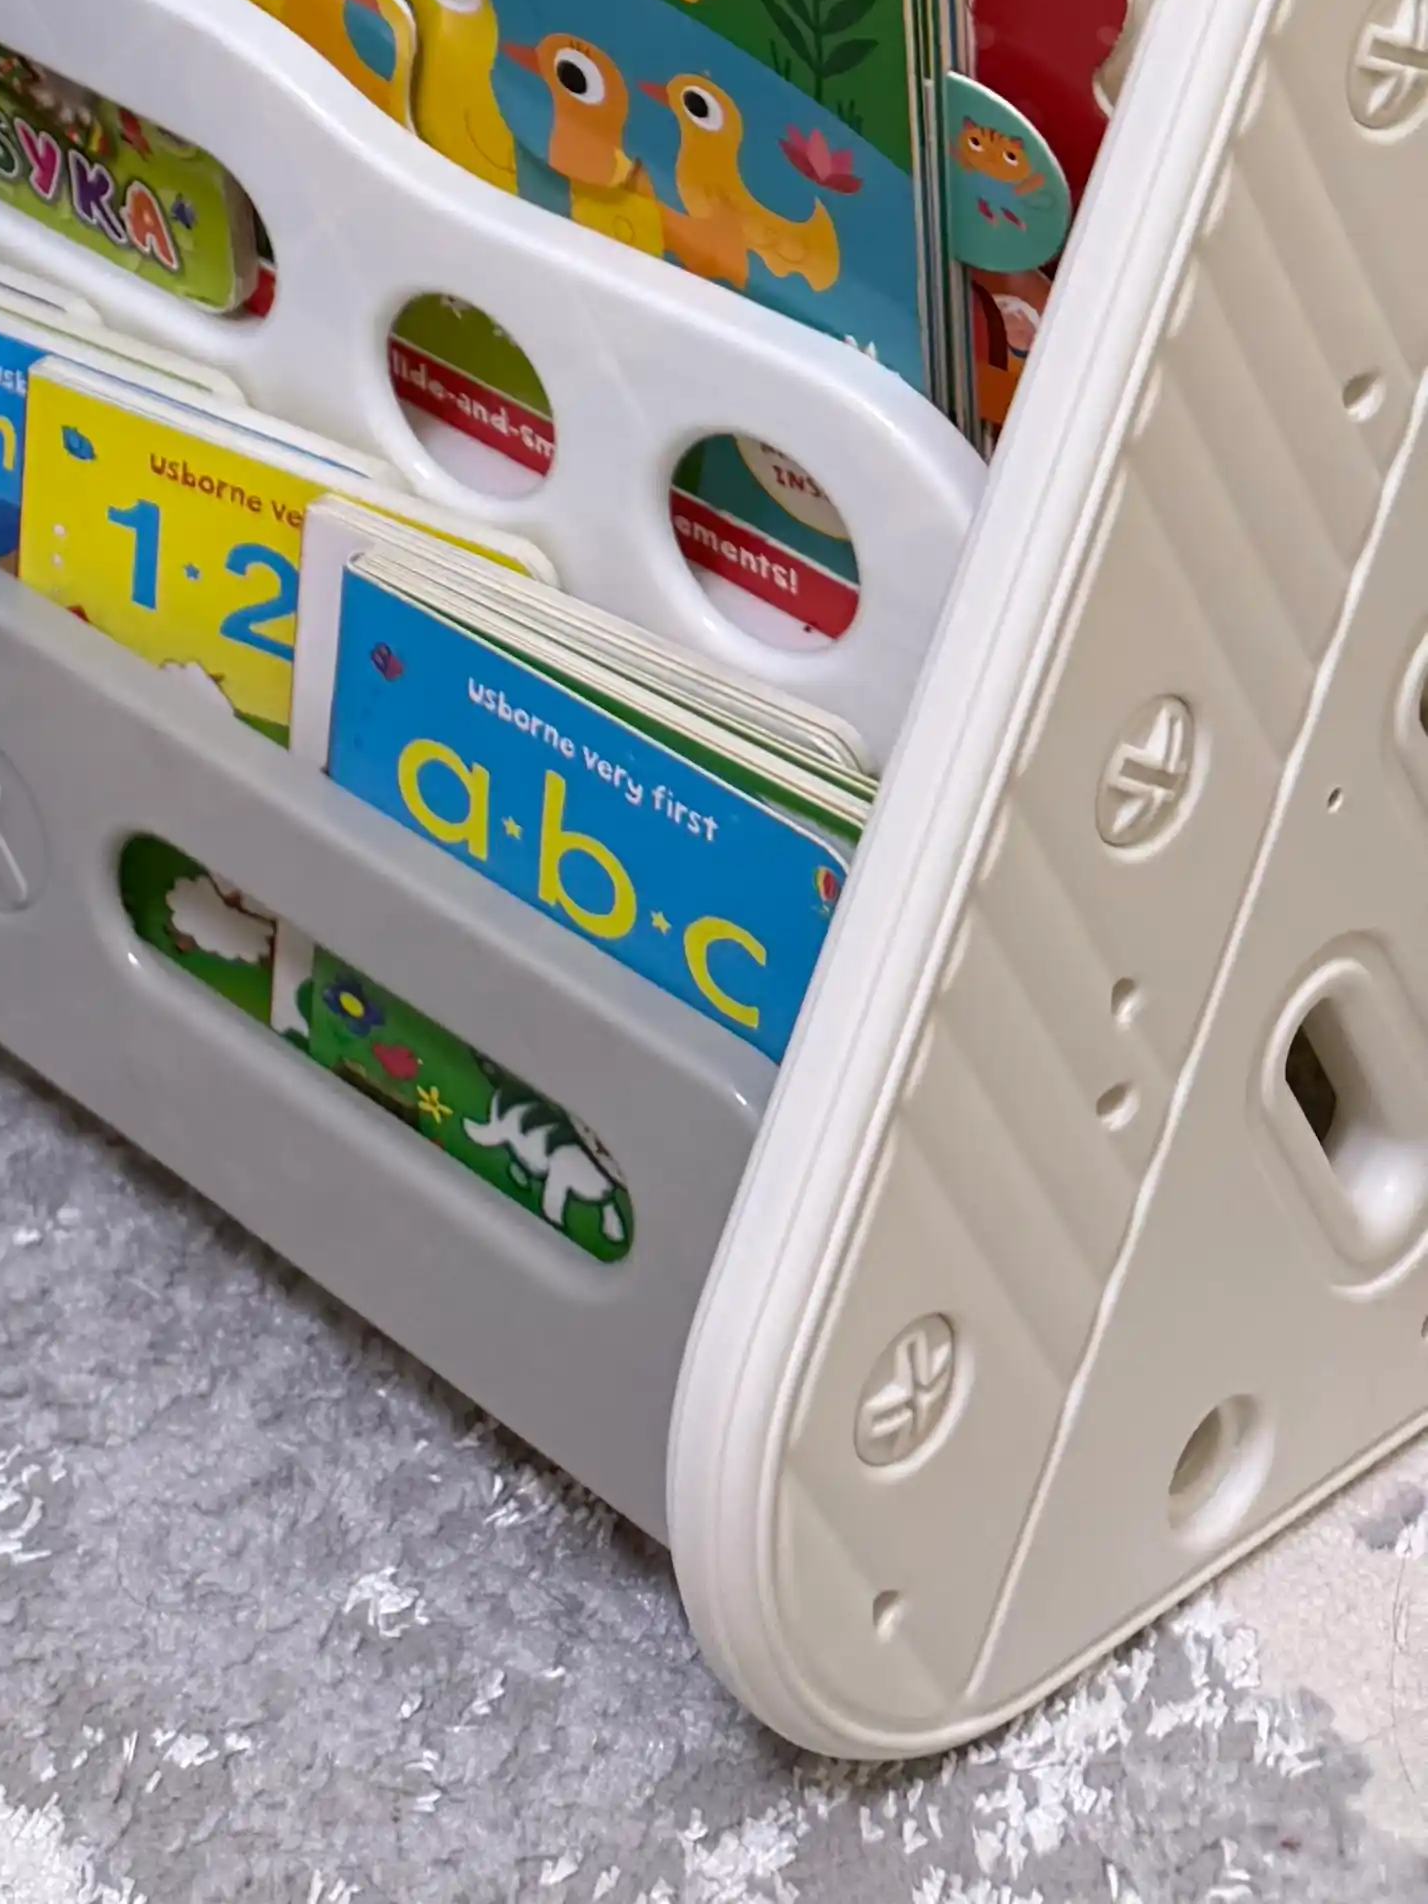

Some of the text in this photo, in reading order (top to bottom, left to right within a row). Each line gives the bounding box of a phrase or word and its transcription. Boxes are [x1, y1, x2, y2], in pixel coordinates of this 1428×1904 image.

[149, 451, 304, 529] usborne ve
[772, 464, 830, 501] INS
[106, 497, 300, 663] 1 2
[673, 513, 798, 597] ements!
[467, 676, 719, 842] usborne very first
[397, 737, 767, 1030] a b c
